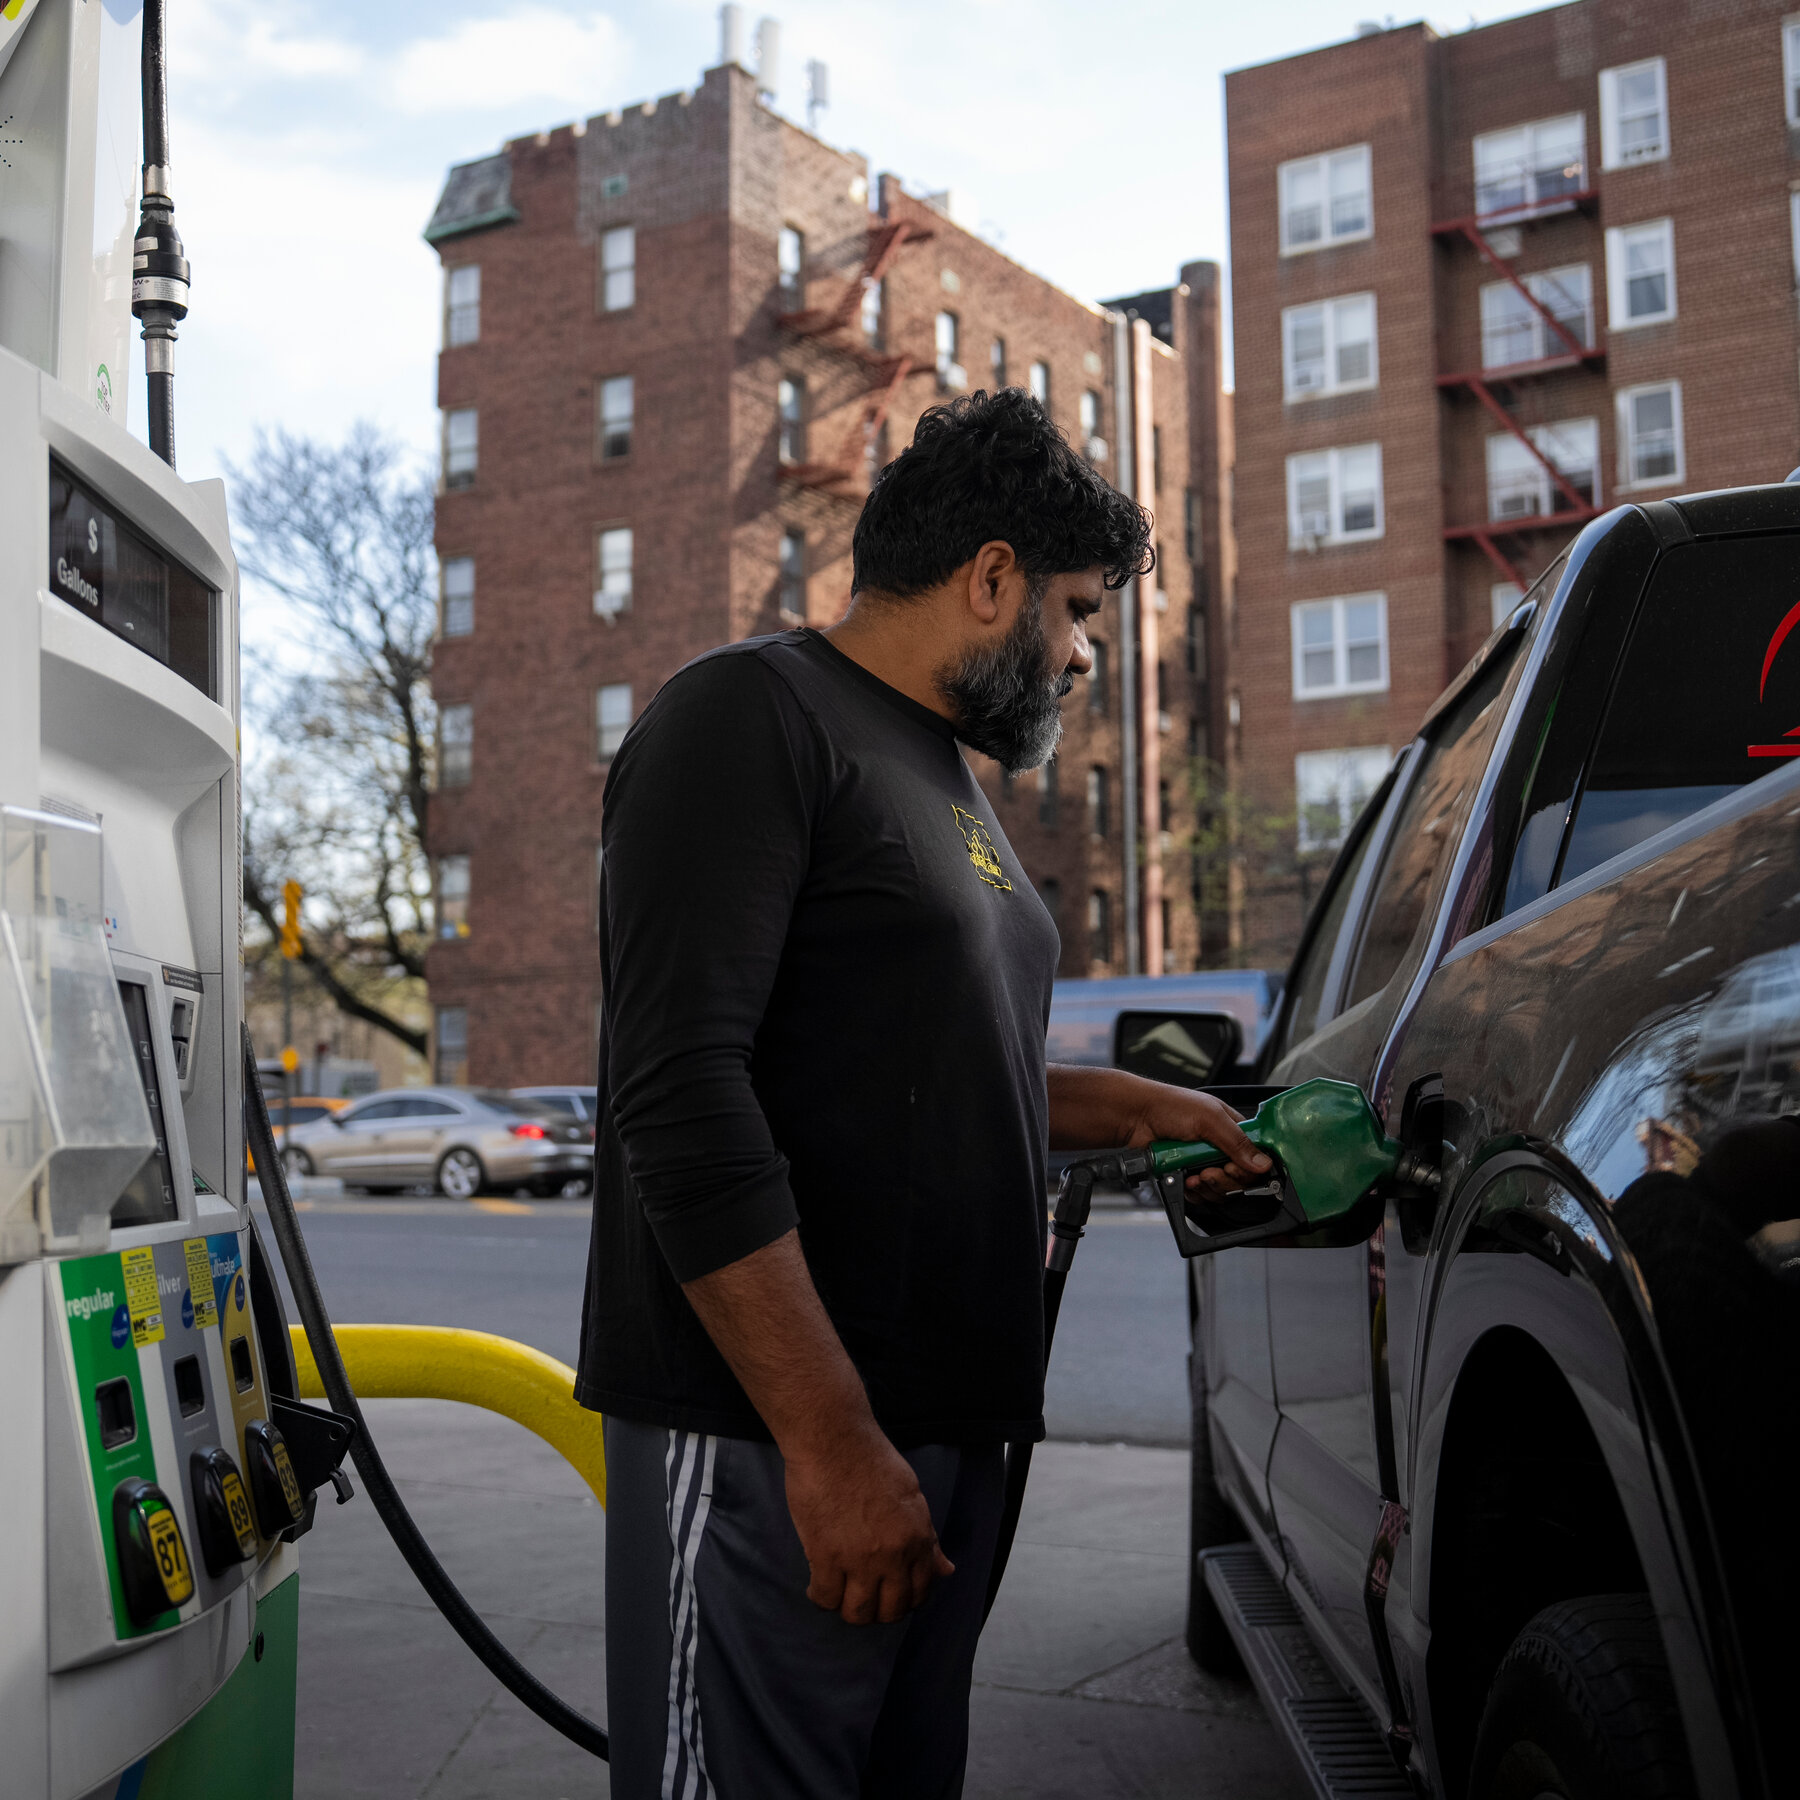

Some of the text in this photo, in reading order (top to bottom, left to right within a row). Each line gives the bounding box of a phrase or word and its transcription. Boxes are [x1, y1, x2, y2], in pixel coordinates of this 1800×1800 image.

[87, 517, 99, 555] $
[57, 557, 99, 607] Gallons
[156, 1274, 182, 1297] ilver
[211, 1256, 235, 1278] ultimate
[67, 1288, 115, 1320] regular
[279, 1463, 298, 1499] 93
[229, 1495, 250, 1533] 89
[156, 1531, 182, 1579] 87
